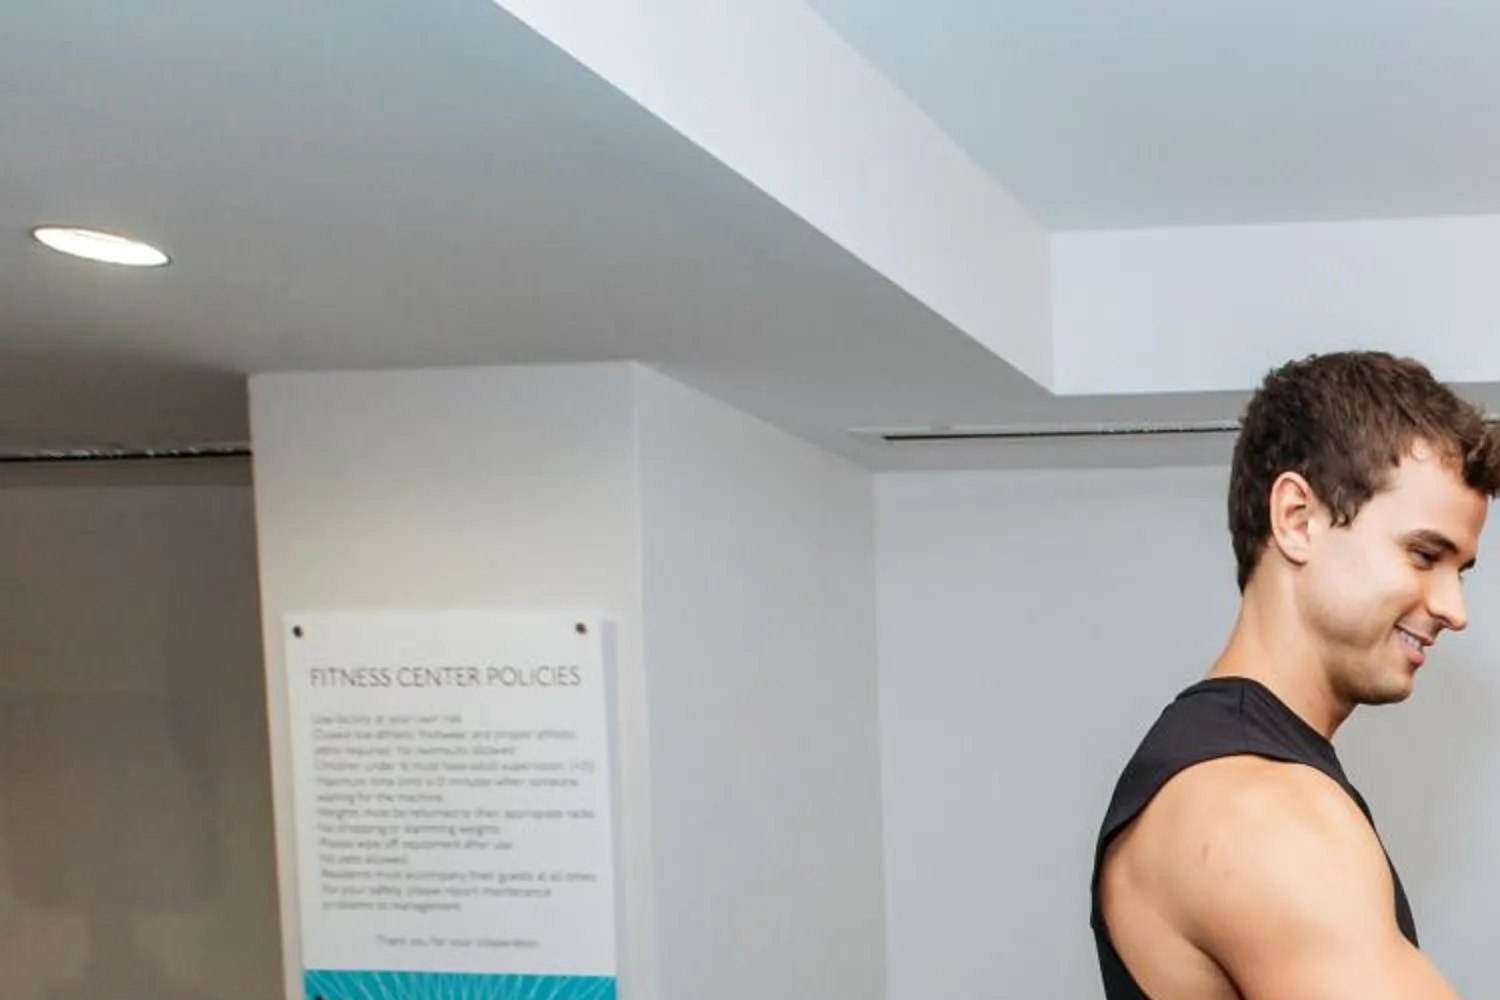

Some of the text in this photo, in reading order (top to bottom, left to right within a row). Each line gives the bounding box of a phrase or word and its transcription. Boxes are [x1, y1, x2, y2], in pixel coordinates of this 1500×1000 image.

[310, 665, 582, 687] FITNESS CENTER POLICIES
